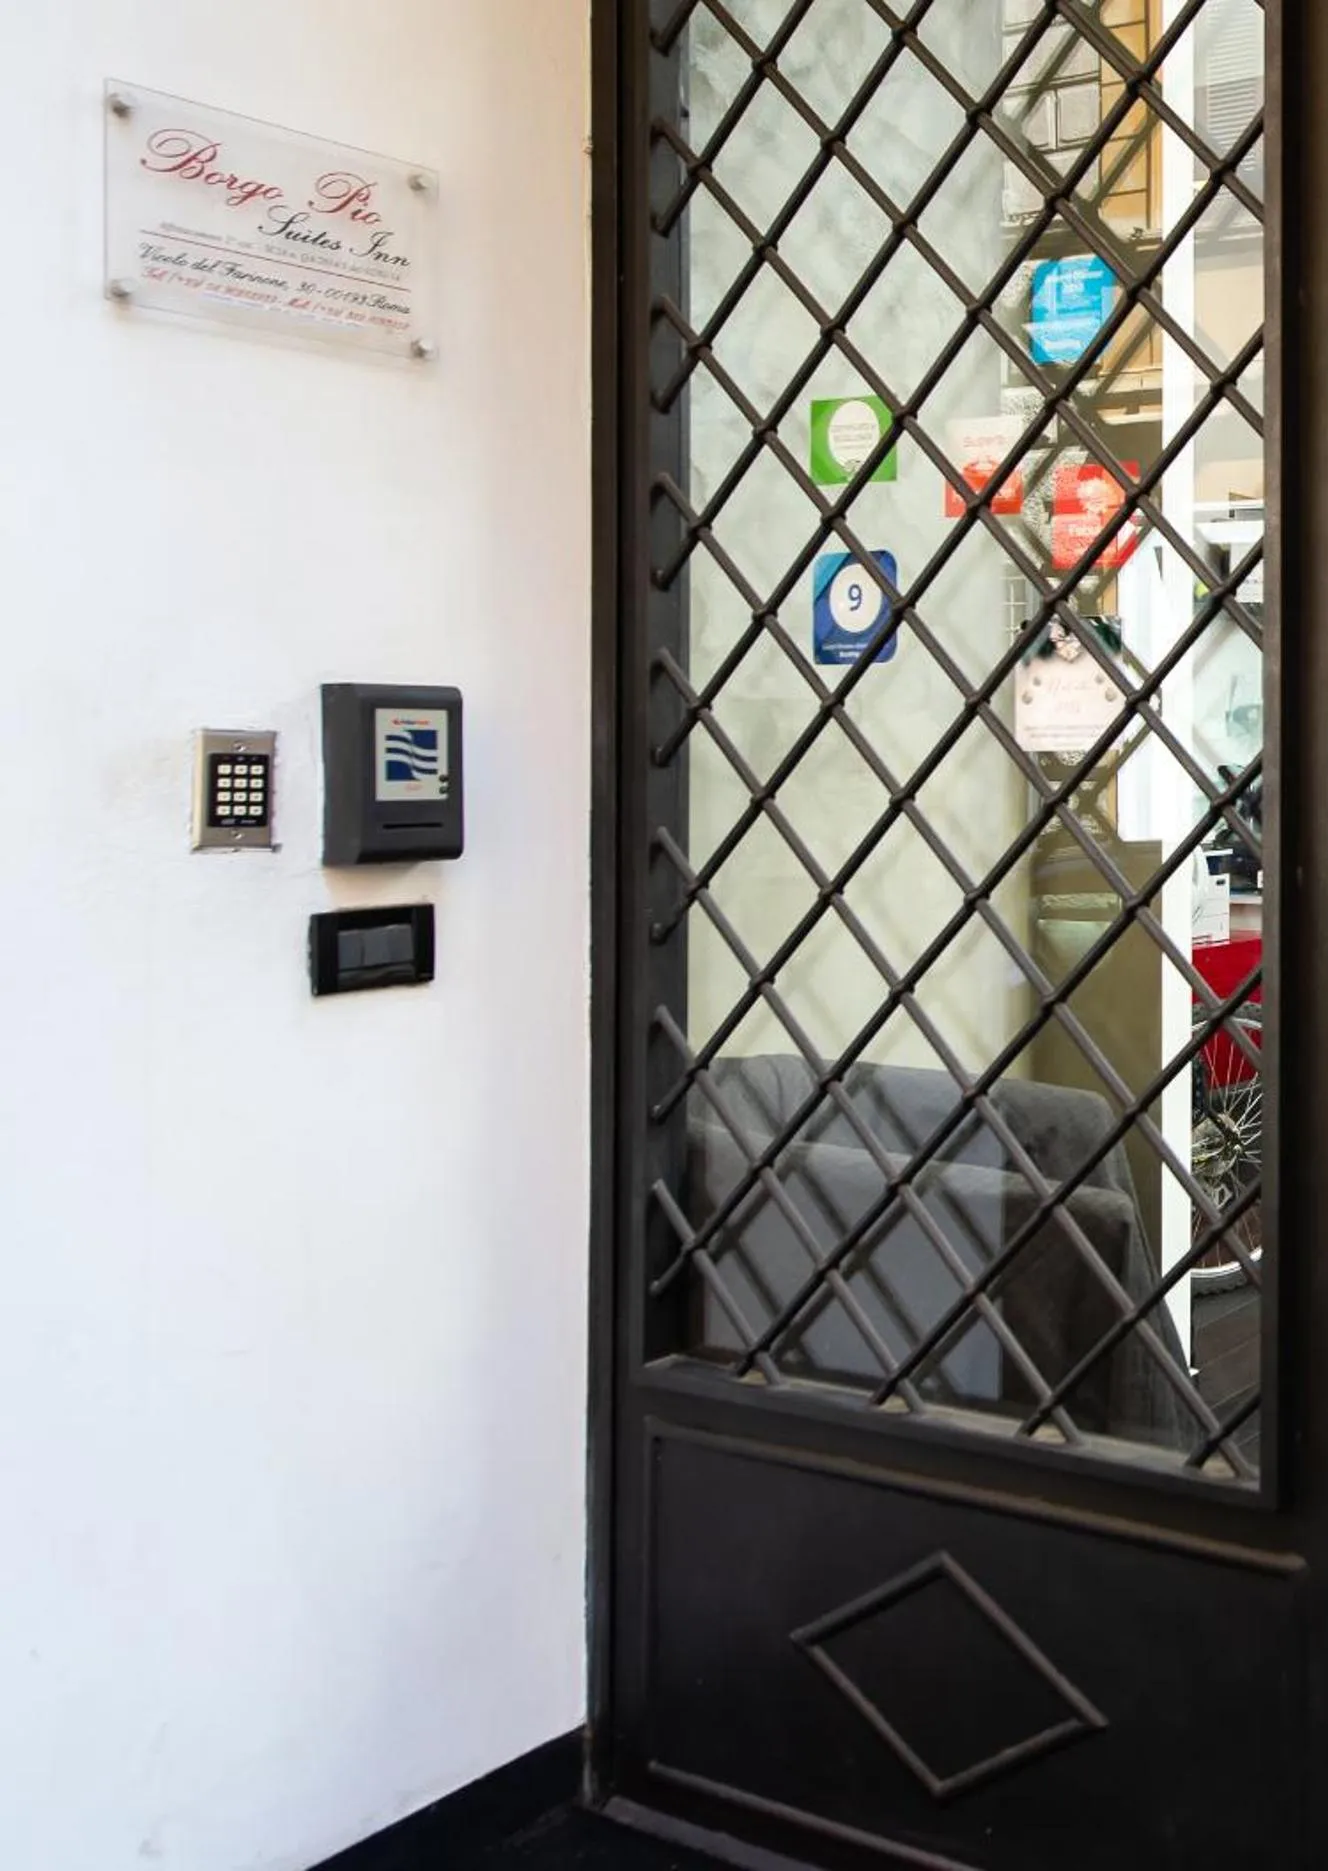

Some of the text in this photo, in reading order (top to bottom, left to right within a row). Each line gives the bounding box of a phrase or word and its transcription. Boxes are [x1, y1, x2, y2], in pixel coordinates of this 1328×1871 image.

[140, 128, 382, 225] Borgo Pio
[257, 205, 342, 252] Suites
[349, 231, 411, 267] Inn
[190, 257, 223, 273] del
[848, 583, 862, 612] 9
